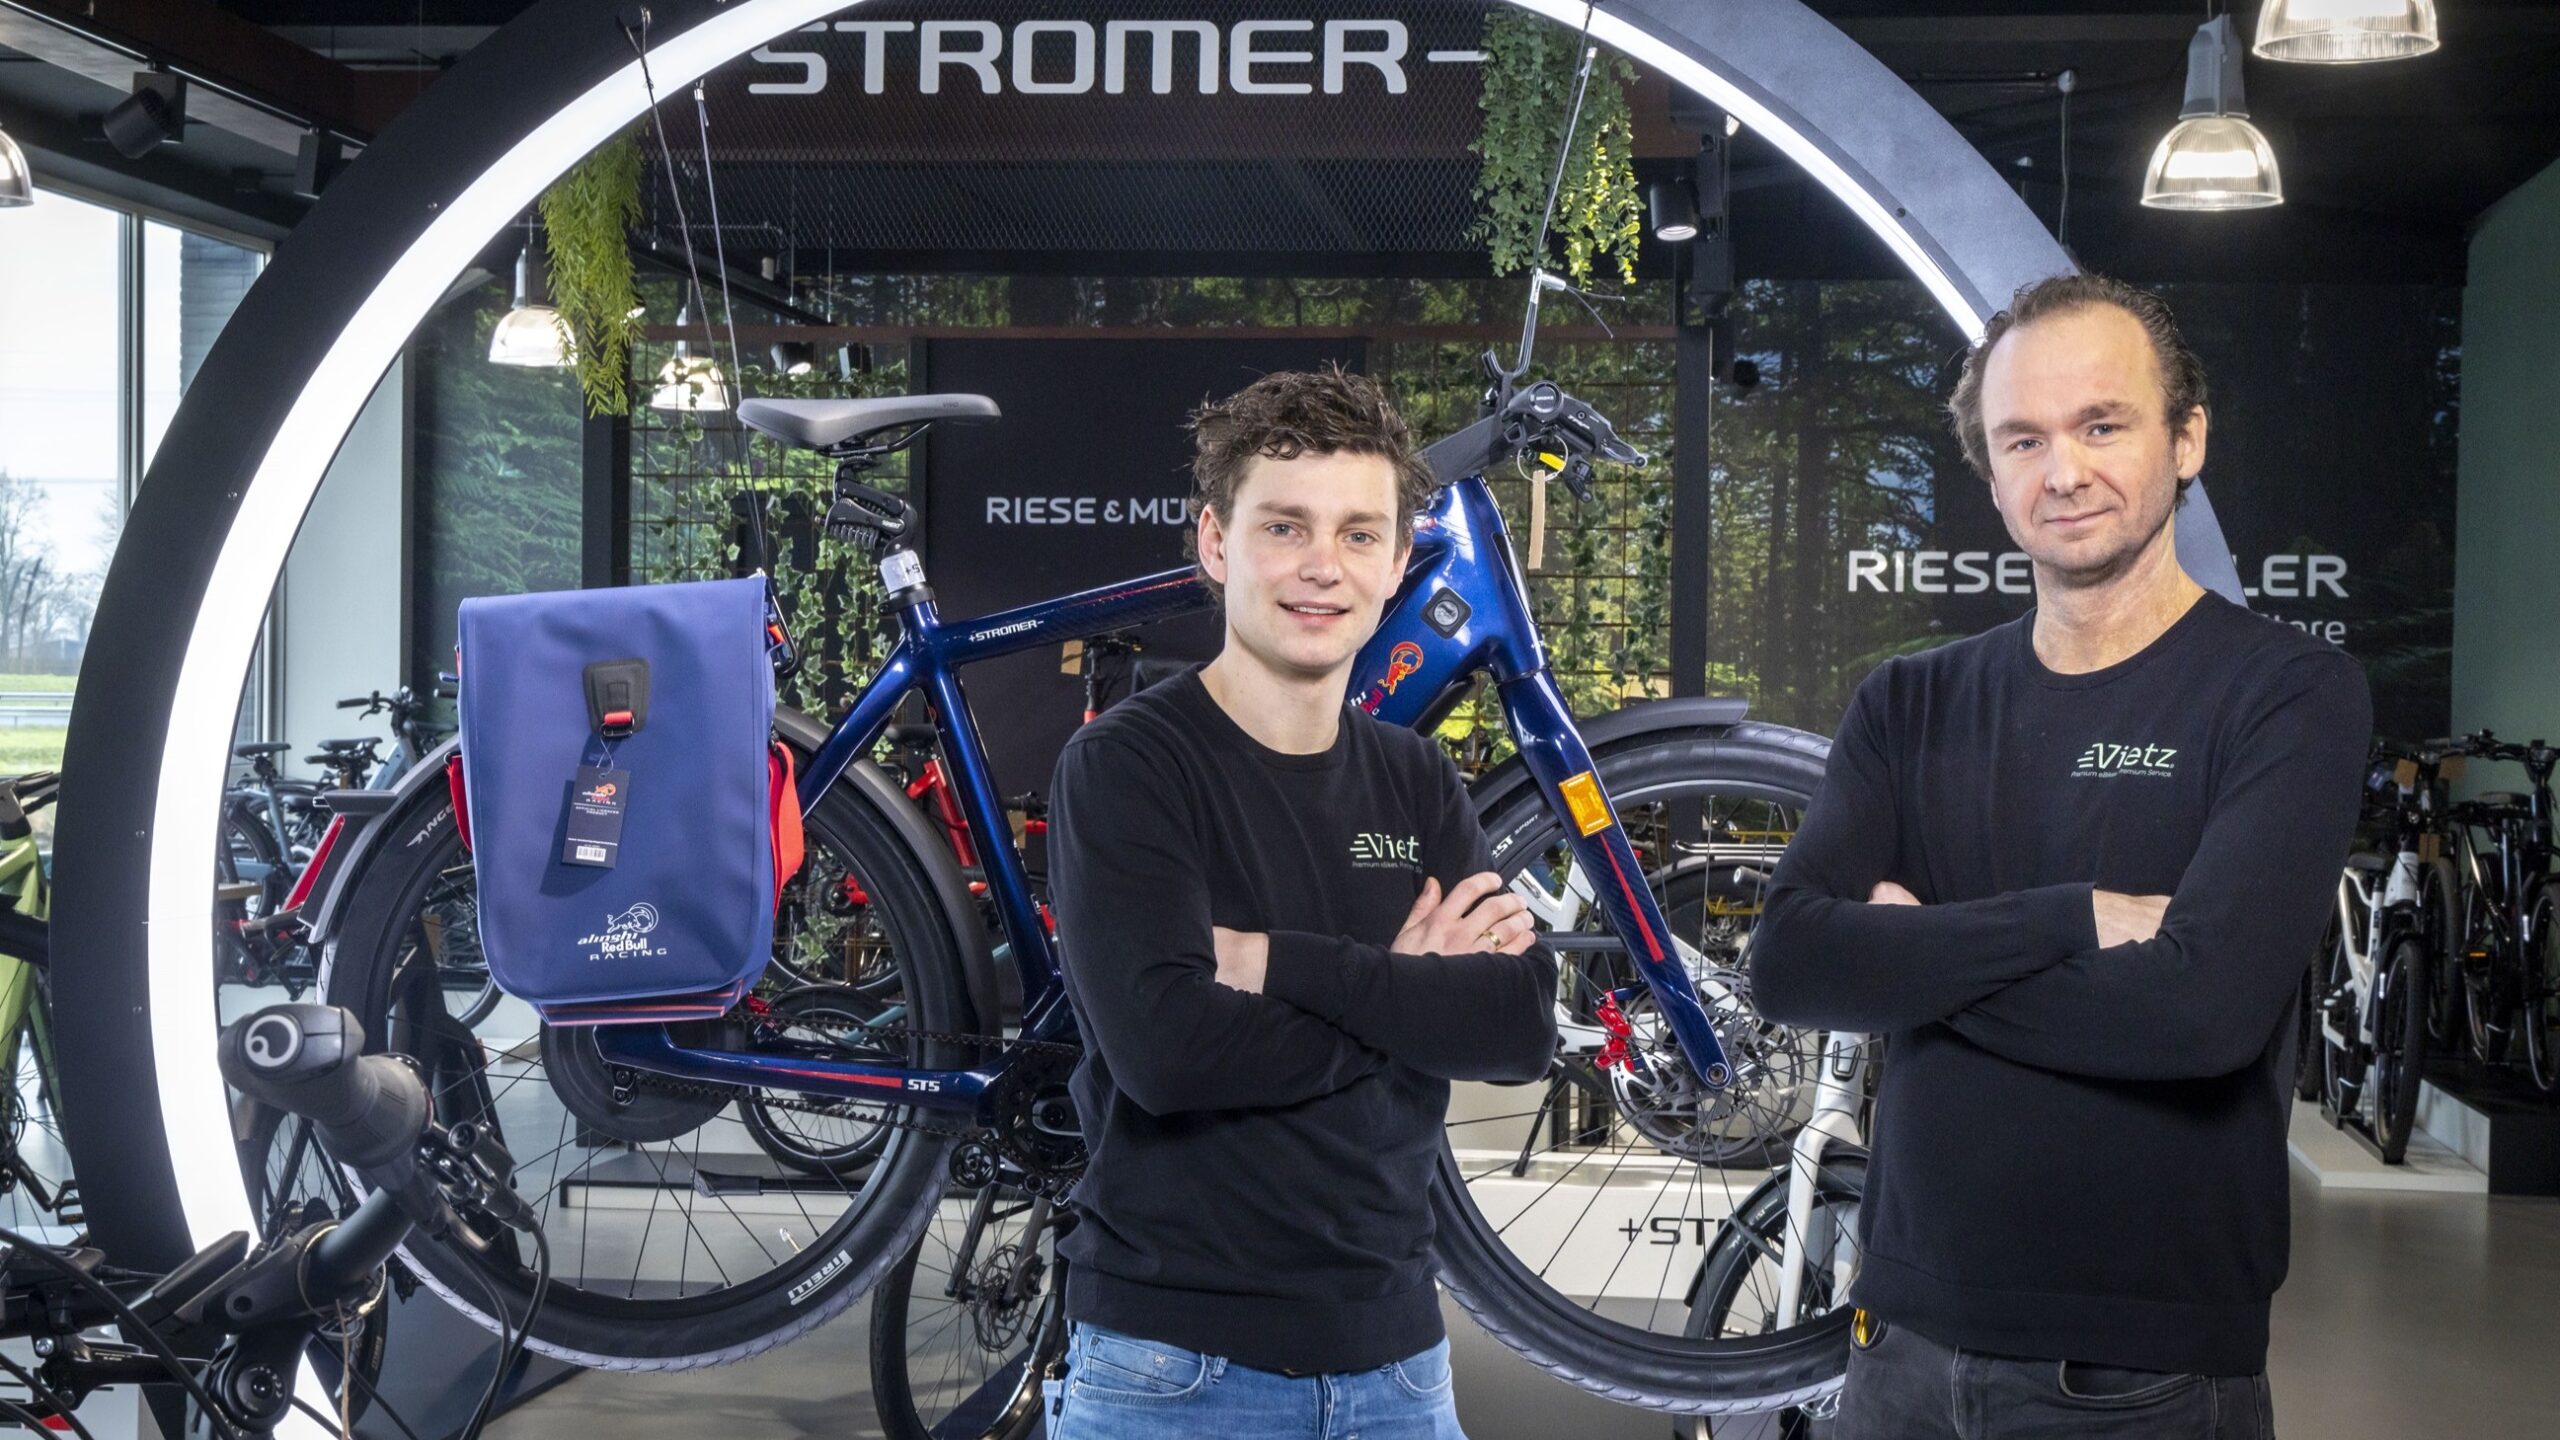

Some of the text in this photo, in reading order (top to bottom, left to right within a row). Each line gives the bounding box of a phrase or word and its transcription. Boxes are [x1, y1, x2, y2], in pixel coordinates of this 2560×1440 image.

[986, 496, 1200, 524] RIESE & MÜ
[1847, 550, 2032, 594] RIESE
[2091, 742, 2178, 769] Vietz
[589, 947, 668, 961] RACING
[1618, 1217, 1730, 1246] +ST
[788, 1249, 854, 1306] PIRELLI
